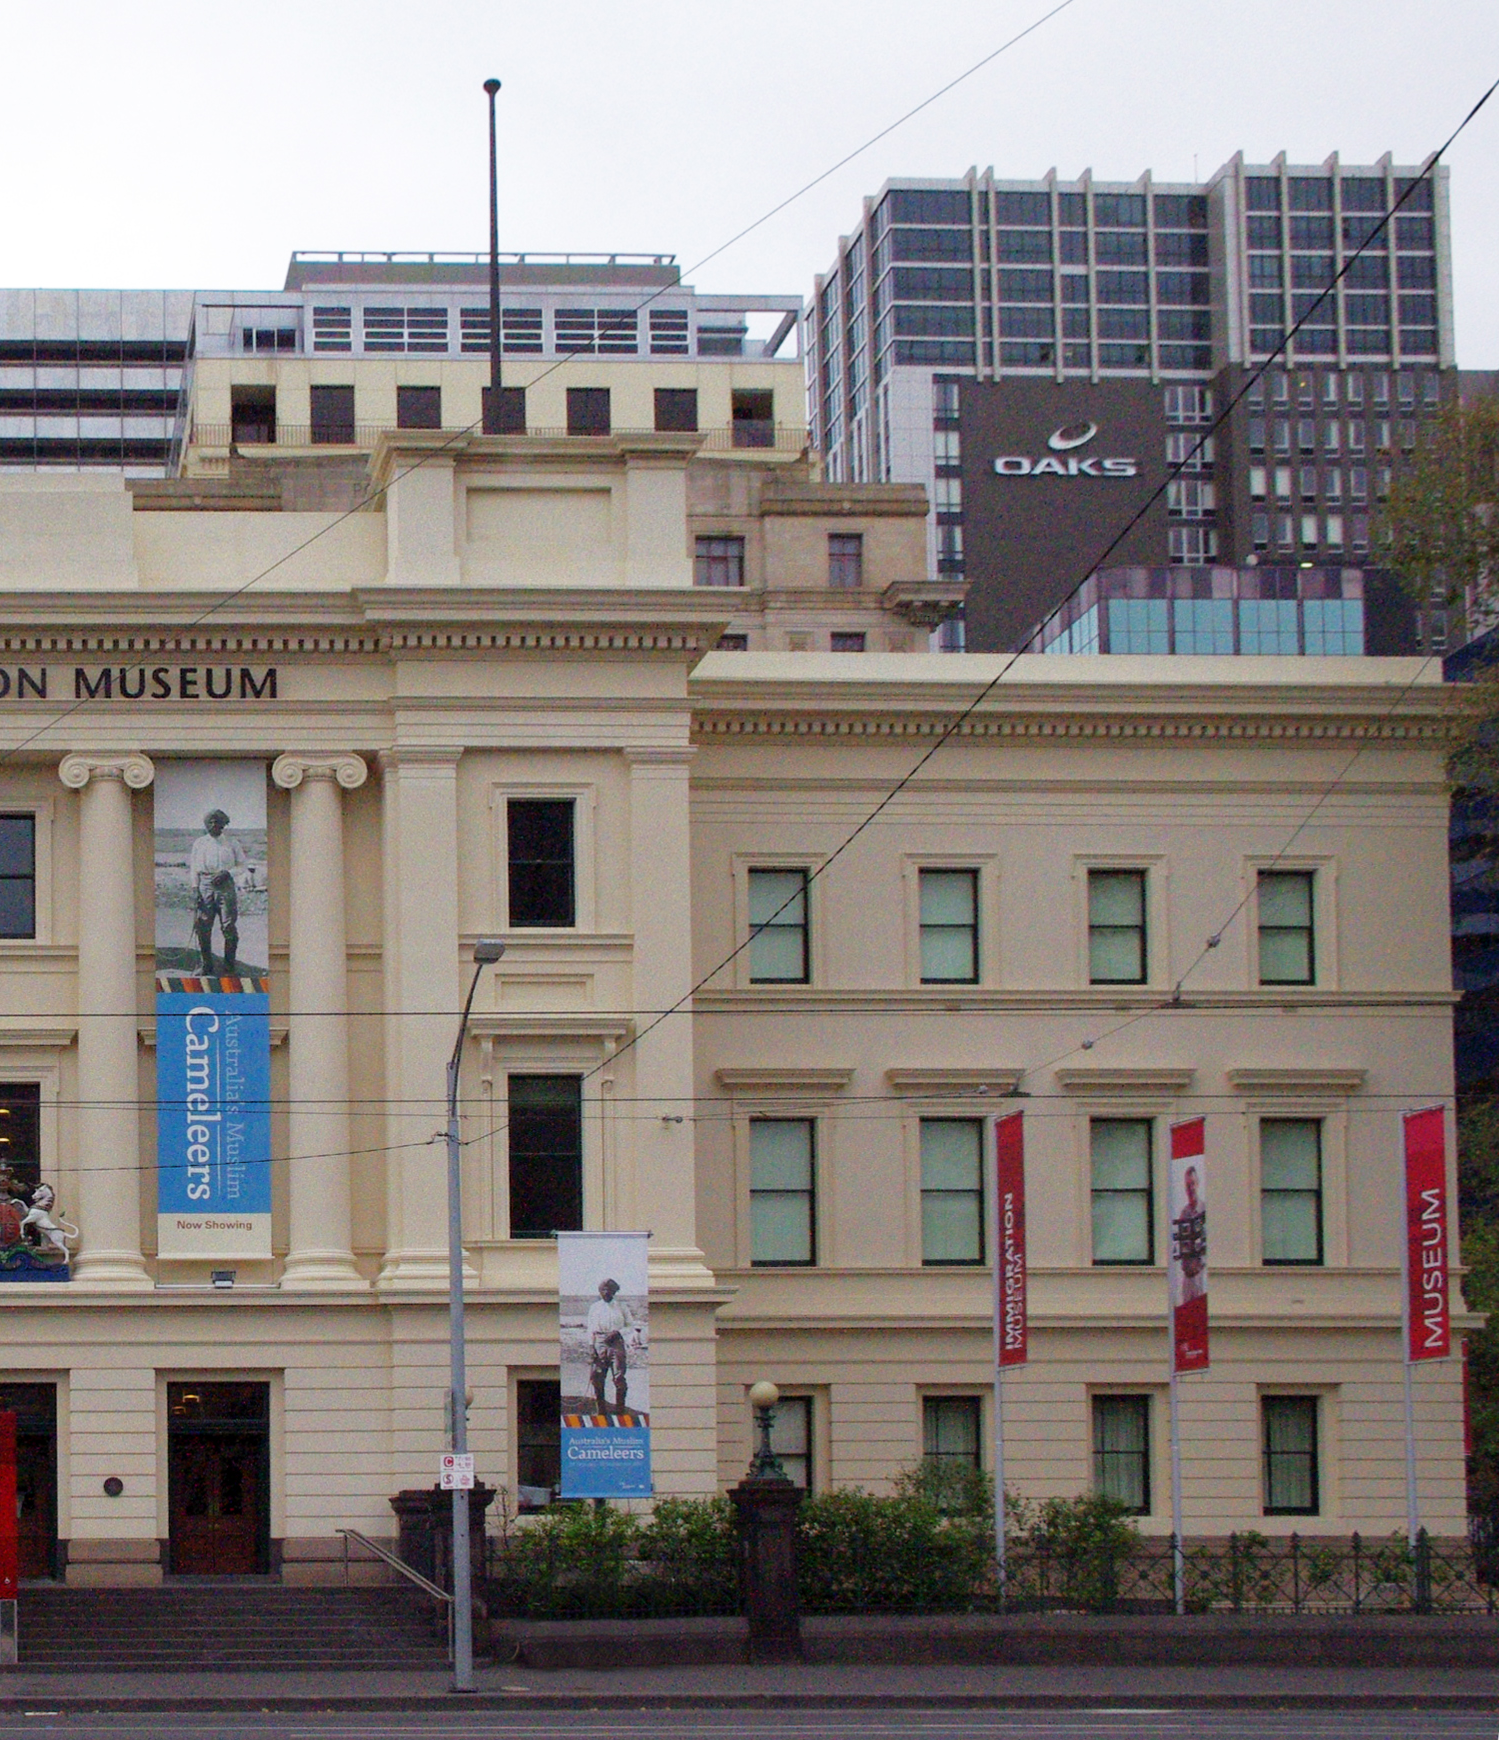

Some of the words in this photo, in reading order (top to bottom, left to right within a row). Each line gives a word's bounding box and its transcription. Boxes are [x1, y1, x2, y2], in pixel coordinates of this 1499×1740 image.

[994, 457, 1137, 476] OAKS
[74, 667, 278, 699] MUSEUM
[186, 1006, 222, 1200] Cameleers
[225, 1010, 245, 1115] Australia's
[226, 1122, 246, 1199] Muslim
[177, 1220, 202, 1230] Now
[205, 1220, 252, 1231] Showing
[1421, 1188, 1444, 1348] MUSEUM
[1004, 1192, 1015, 1350] IMMIGRATION
[1013, 1253, 1024, 1350] MUSEUM
[567, 1446, 644, 1460] Cameleers
